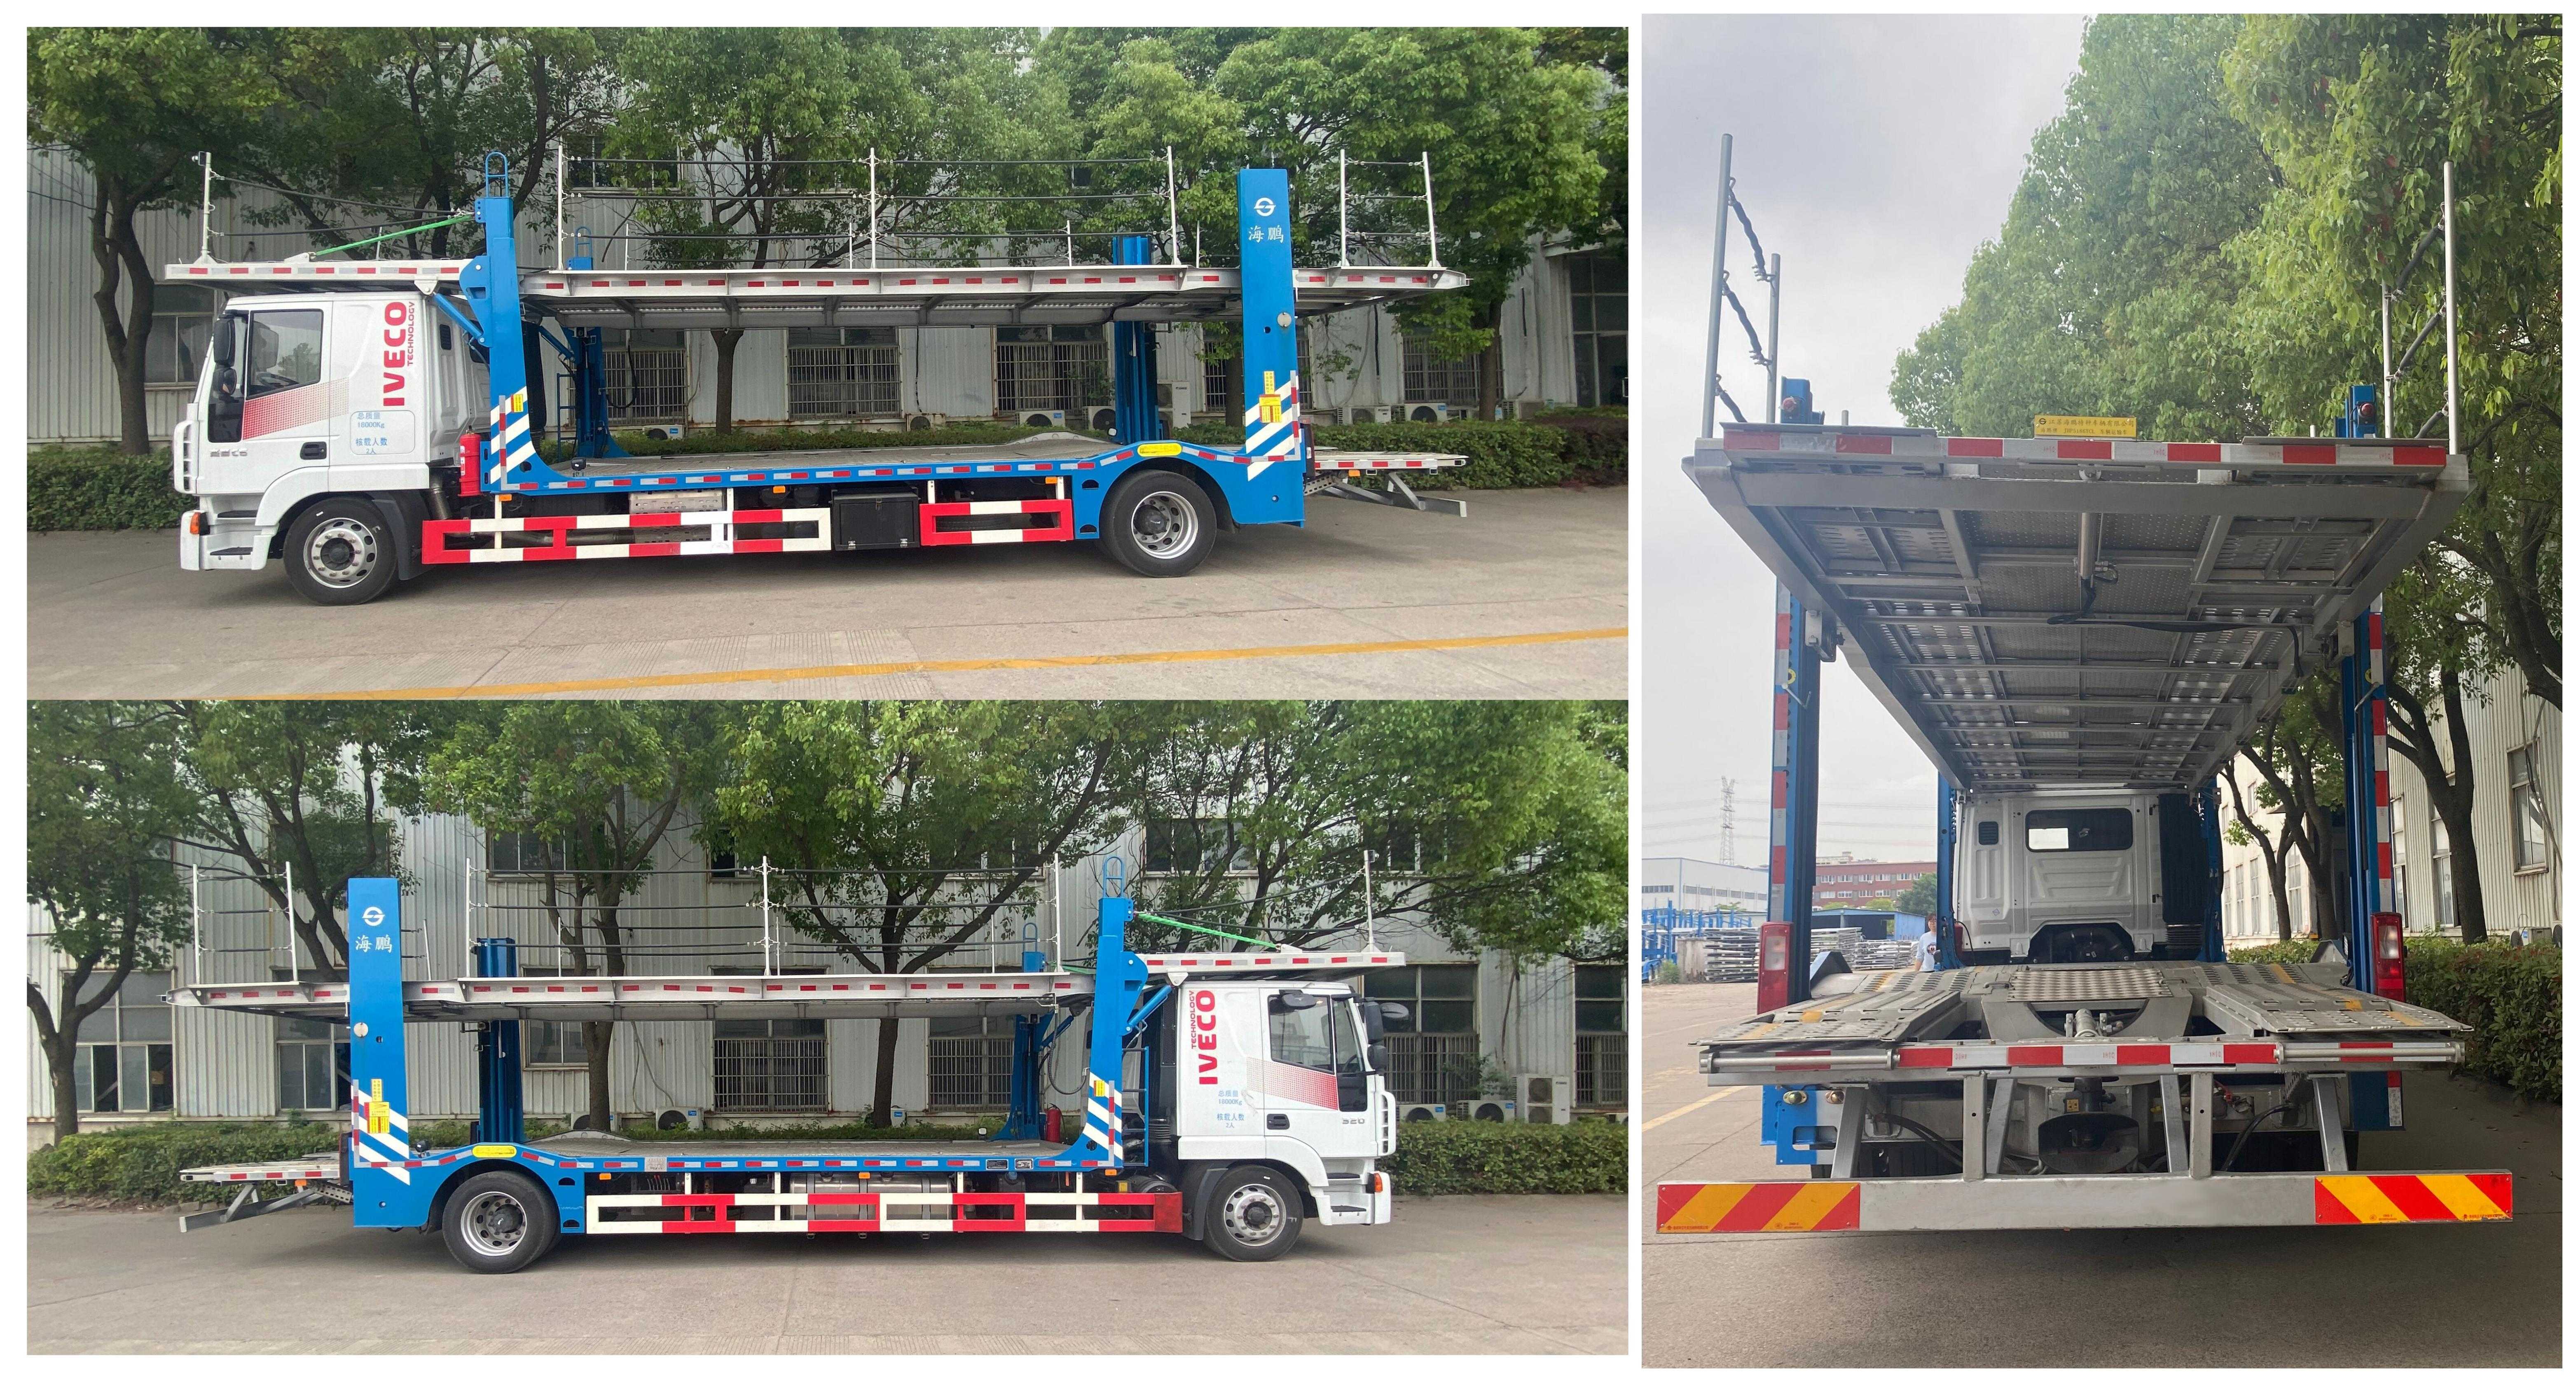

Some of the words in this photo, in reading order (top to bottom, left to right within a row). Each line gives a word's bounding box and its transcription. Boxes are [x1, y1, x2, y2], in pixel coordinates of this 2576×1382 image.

[1248, 225, 1284, 243] 海鹏
[383, 302, 407, 406] IVECO
[356, 437, 388, 446] 核载人数
[355, 934, 393, 953] 海鹏
[1196, 990, 1218, 1085] IVECO
[1217, 1113, 1245, 1121] 核载人数
